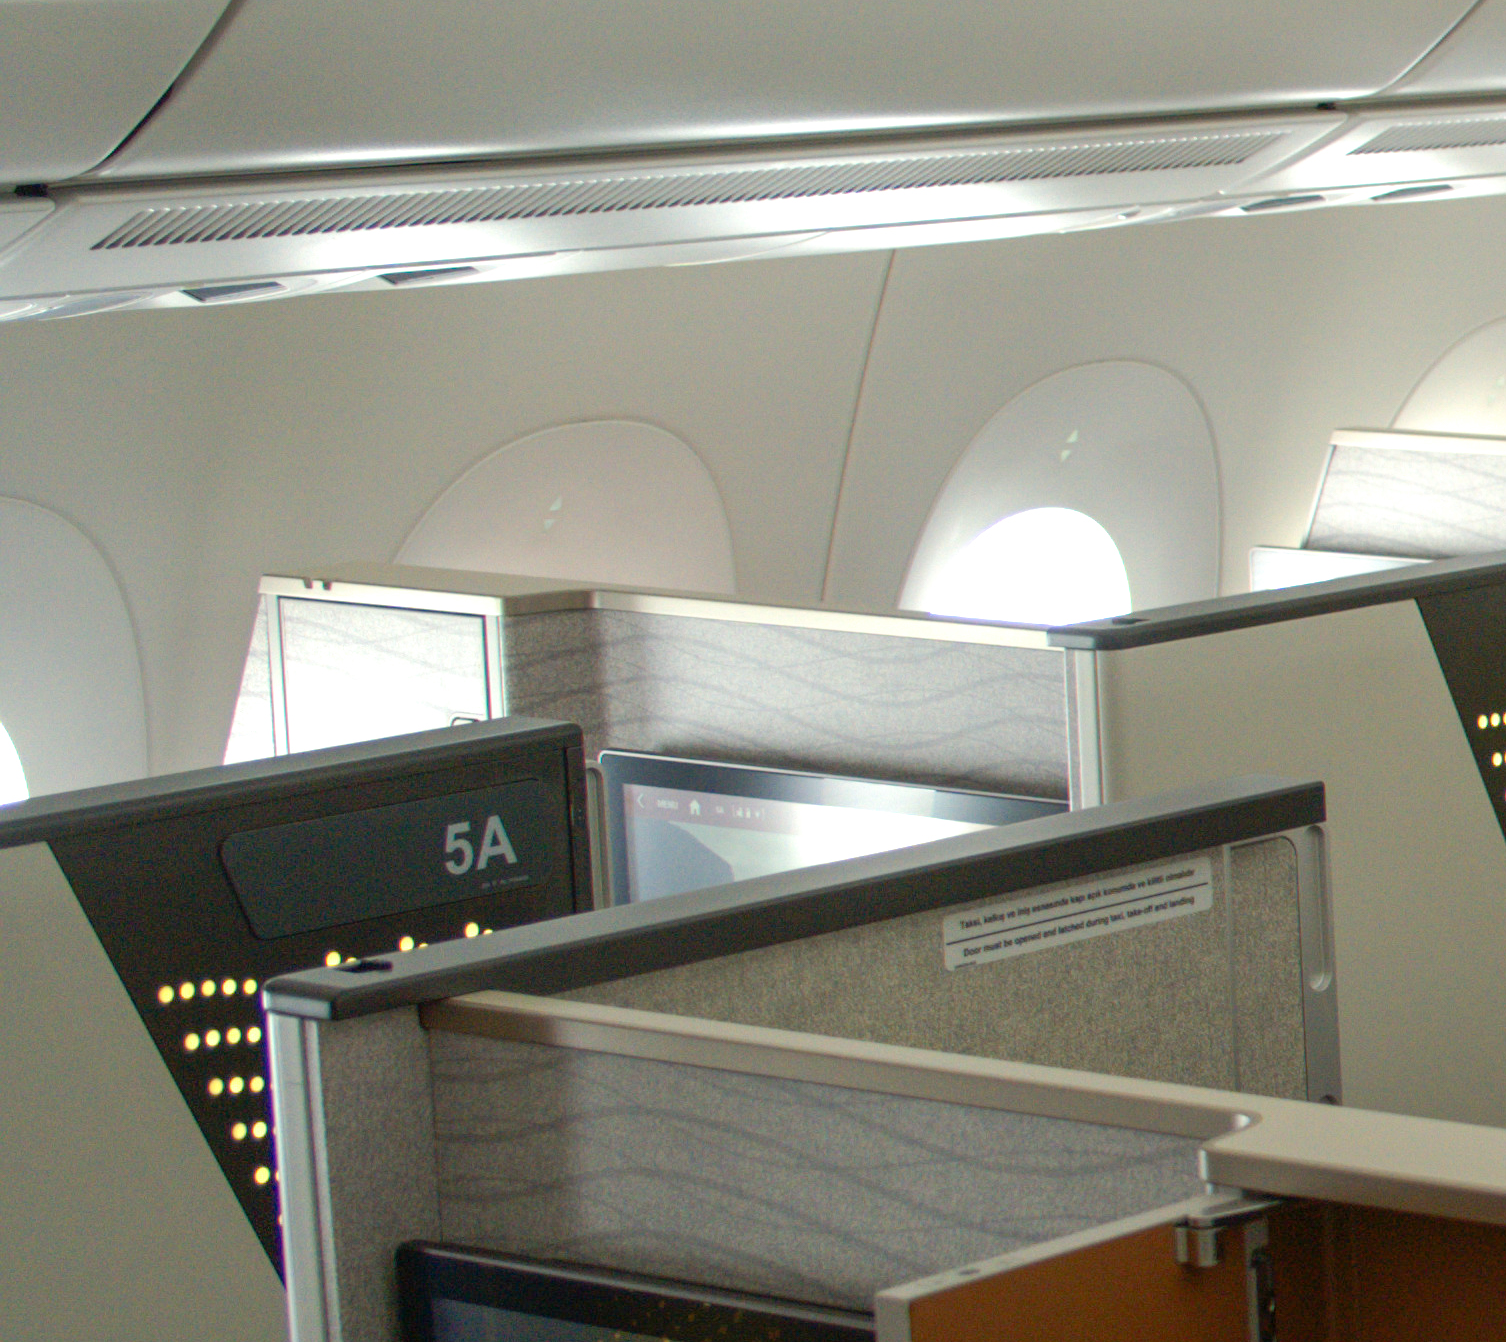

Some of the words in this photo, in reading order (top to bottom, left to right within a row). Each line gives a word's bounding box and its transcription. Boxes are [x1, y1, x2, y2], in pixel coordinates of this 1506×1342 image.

[445, 814, 518, 876] 5A
[963, 946, 981, 957] Door
[983, 940, 1002, 952] must
[1003, 939, 1013, 948] be
[1014, 931, 1041, 946] opened
[1042, 927, 1057, 938] and
[1058, 921, 1084, 935] latched
[1086, 916, 1109, 928] during
[1127, 905, 1153, 918] take-off
[1154, 902, 1168, 912] and
[1169, 896, 1195, 908] landing
[1006, 910, 1016, 919] ve
[1137, 880, 1146, 888] ve
